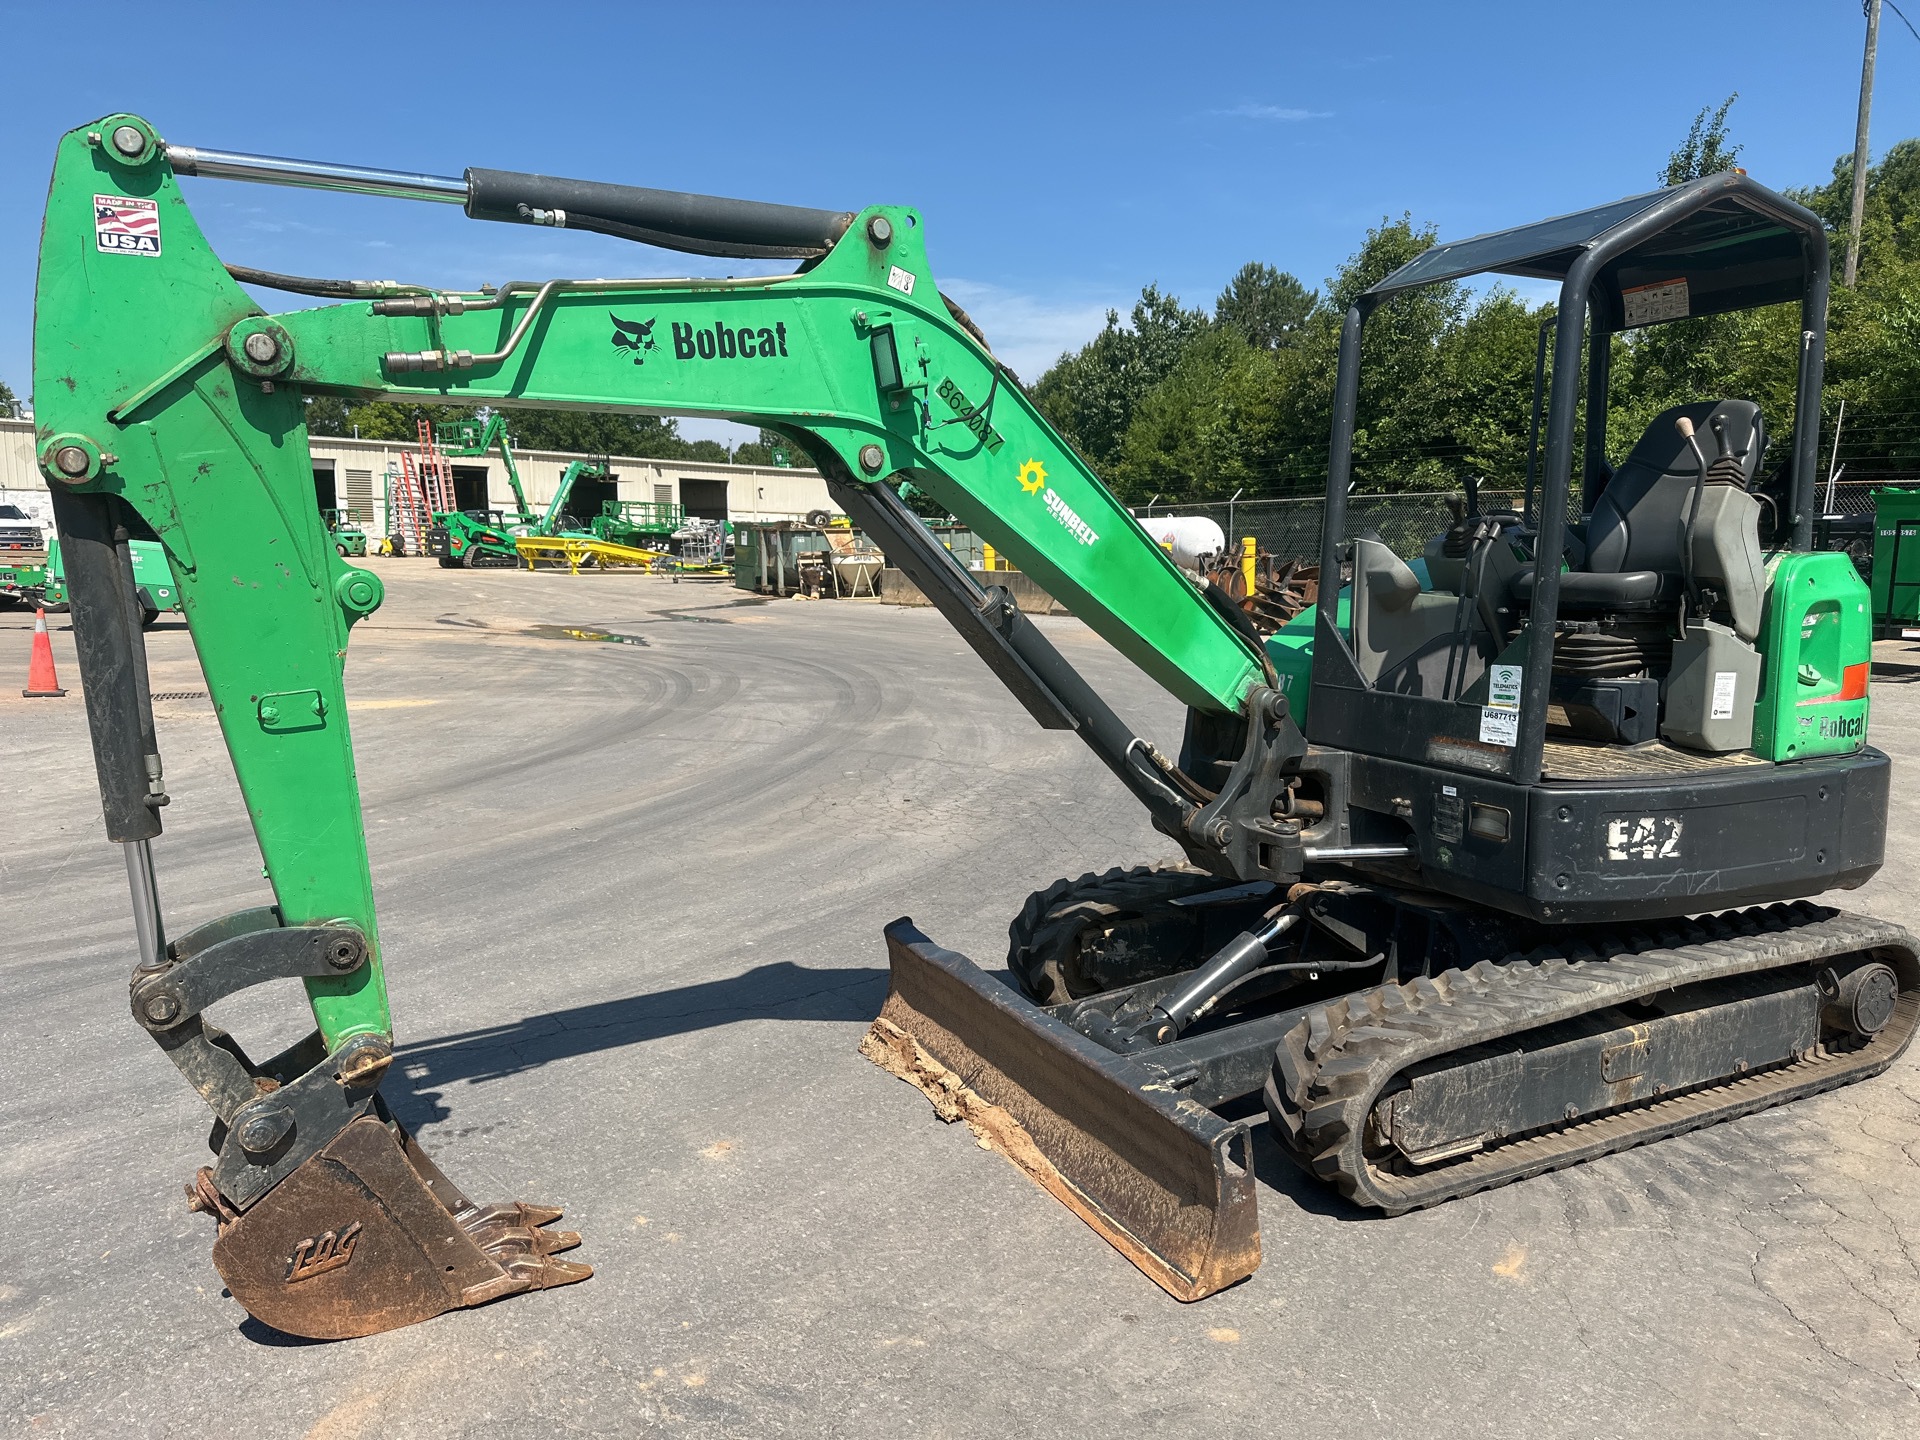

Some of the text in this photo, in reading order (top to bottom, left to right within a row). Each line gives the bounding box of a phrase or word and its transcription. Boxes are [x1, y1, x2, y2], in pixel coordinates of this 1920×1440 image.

[98, 198, 123, 207] MADE
[136, 202, 153, 210] THE
[101, 234, 156, 250] USA
[671, 321, 788, 360] Bobcat
[939, 379, 1005, 450] 864087
[1042, 487, 1100, 546] SUNBELT
[1046, 506, 1085, 546] RENTALS
[1484, 711, 1517, 722] U687713
[1607, 817, 1683, 861] E42
